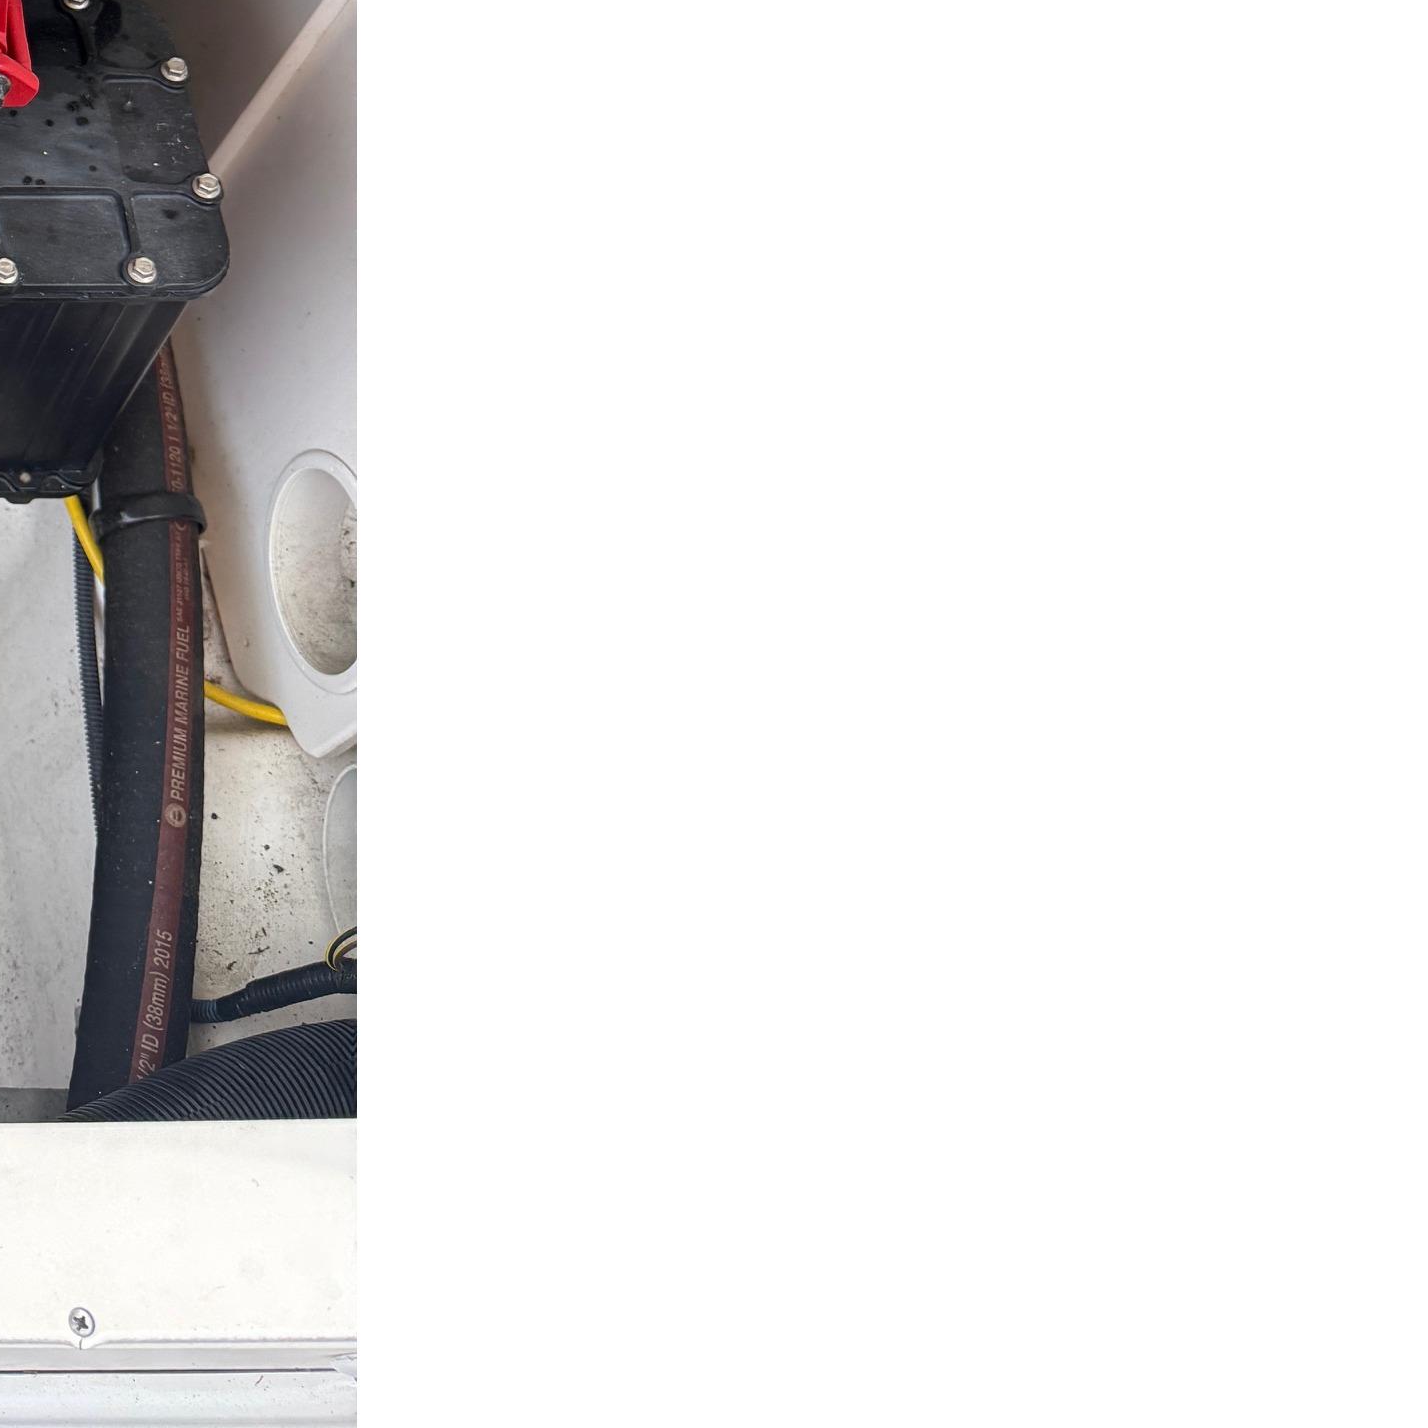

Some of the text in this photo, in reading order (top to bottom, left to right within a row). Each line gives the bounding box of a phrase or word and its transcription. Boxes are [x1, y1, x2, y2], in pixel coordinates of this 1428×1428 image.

[175, 624, 190, 661] FUEL
[174, 664, 190, 724] MARINE
[169, 727, 189, 801] PREMIUM
[152, 929, 173, 969] 2015
[142, 970, 171, 1032] (38mm)
[142, 1034, 161, 1053] ID
